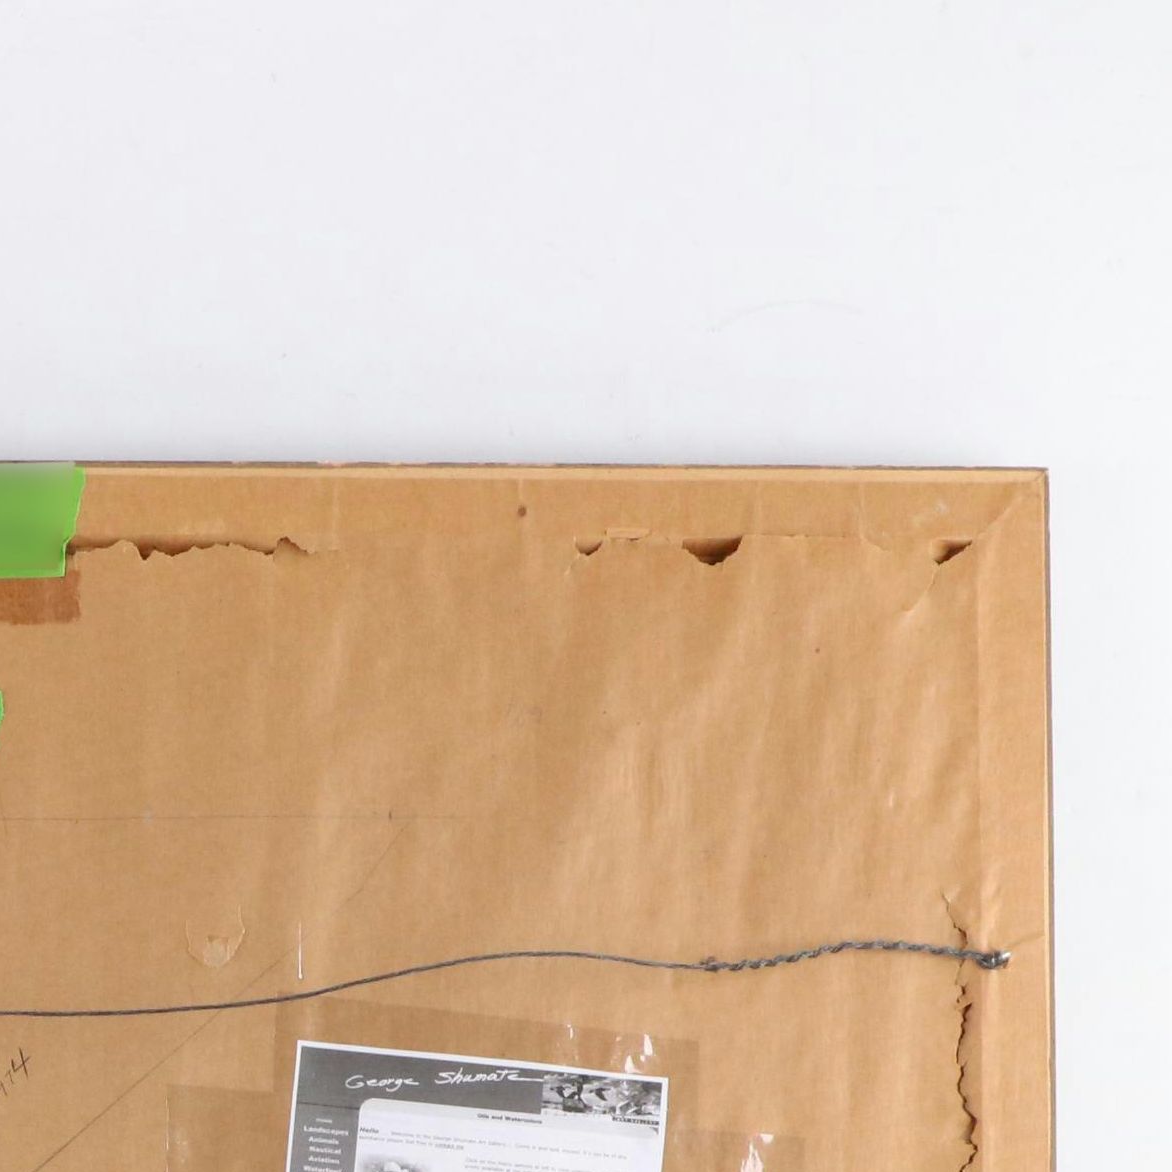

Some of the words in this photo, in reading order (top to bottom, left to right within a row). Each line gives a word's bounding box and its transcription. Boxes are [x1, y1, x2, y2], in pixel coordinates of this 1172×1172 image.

[345, 1074, 420, 1093] George
[434, 1067, 544, 1085] Shumate
[303, 1125, 349, 1137] Landscapes
[308, 1136, 340, 1145] Animals
[309, 1146, 342, 1155] Nautical
[308, 1155, 340, 1165] Aviation
